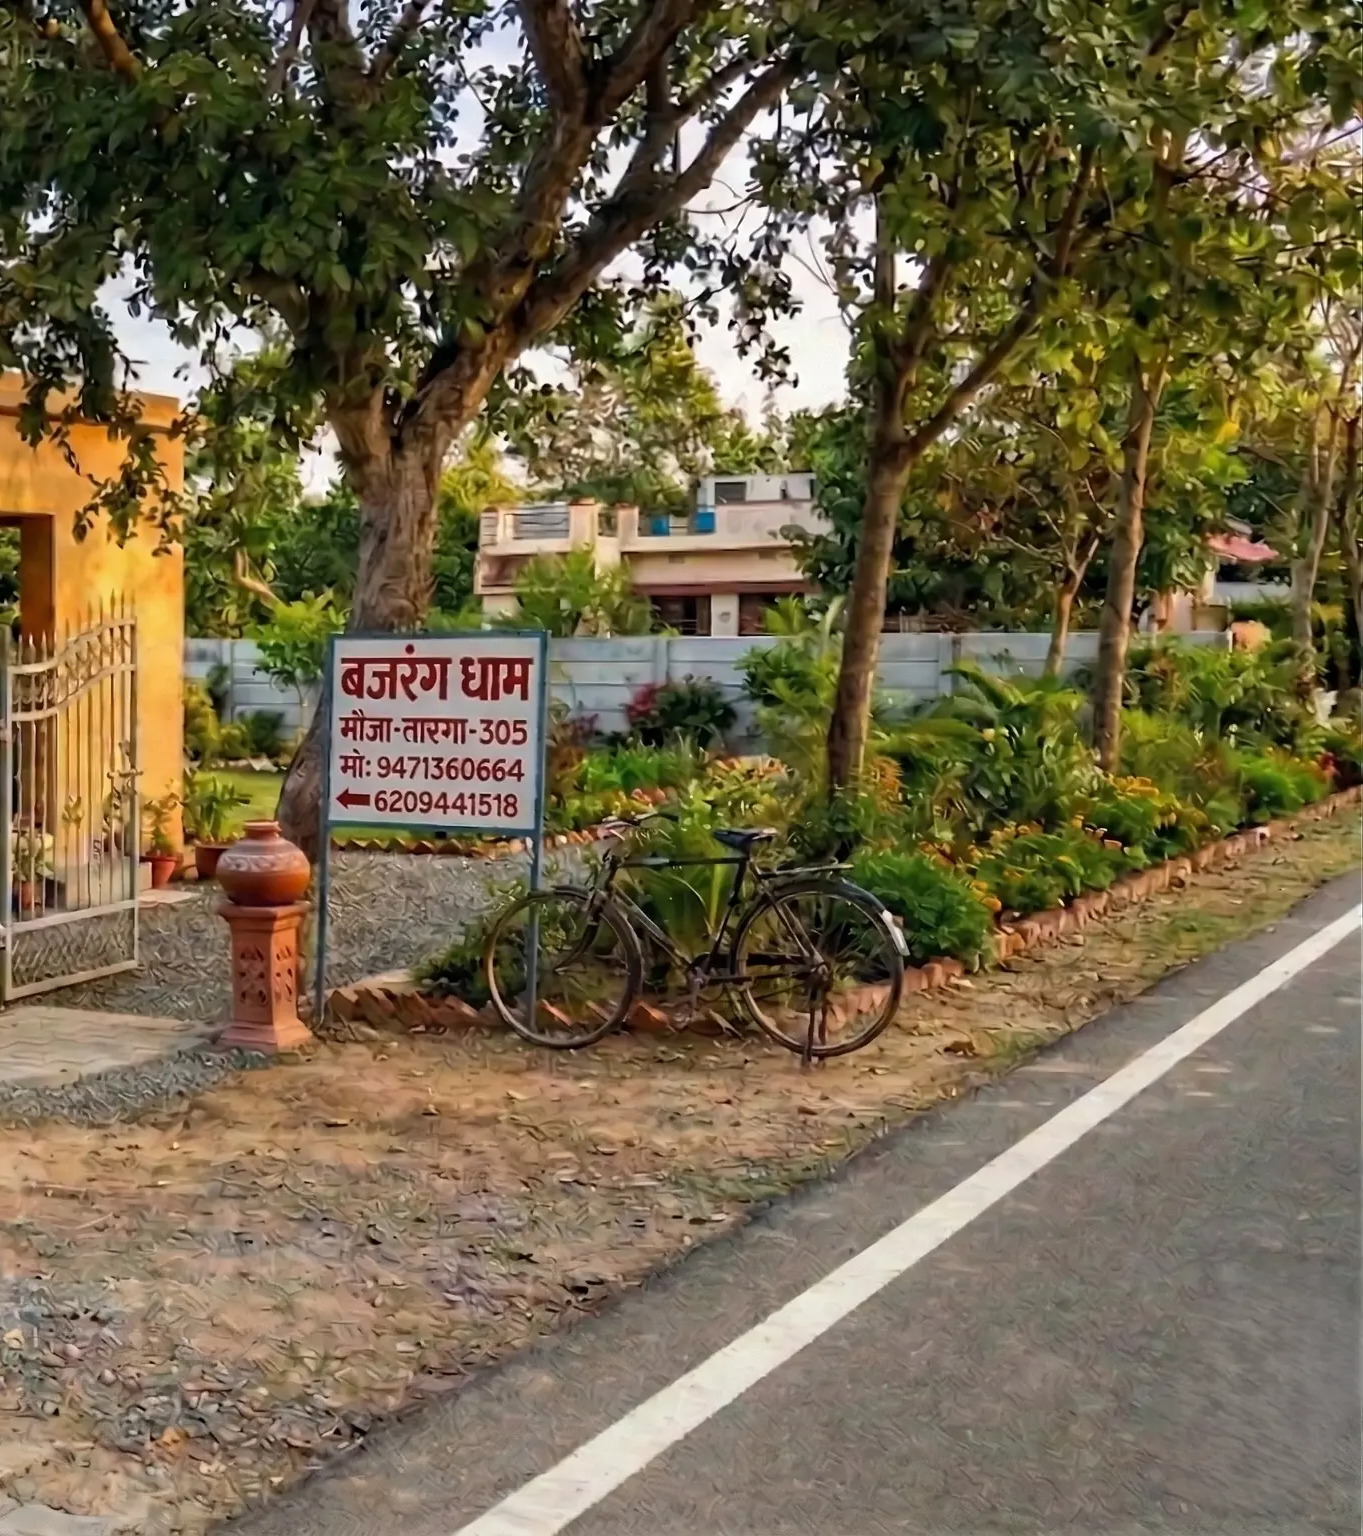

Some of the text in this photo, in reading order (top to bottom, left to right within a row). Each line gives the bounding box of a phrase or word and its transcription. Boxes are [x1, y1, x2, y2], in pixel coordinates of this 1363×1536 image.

[341, 644, 533, 701] बजरंग धाम
[339, 748, 525, 782] मो: 9471360664
[375, 790, 518, 817] 6209441518
